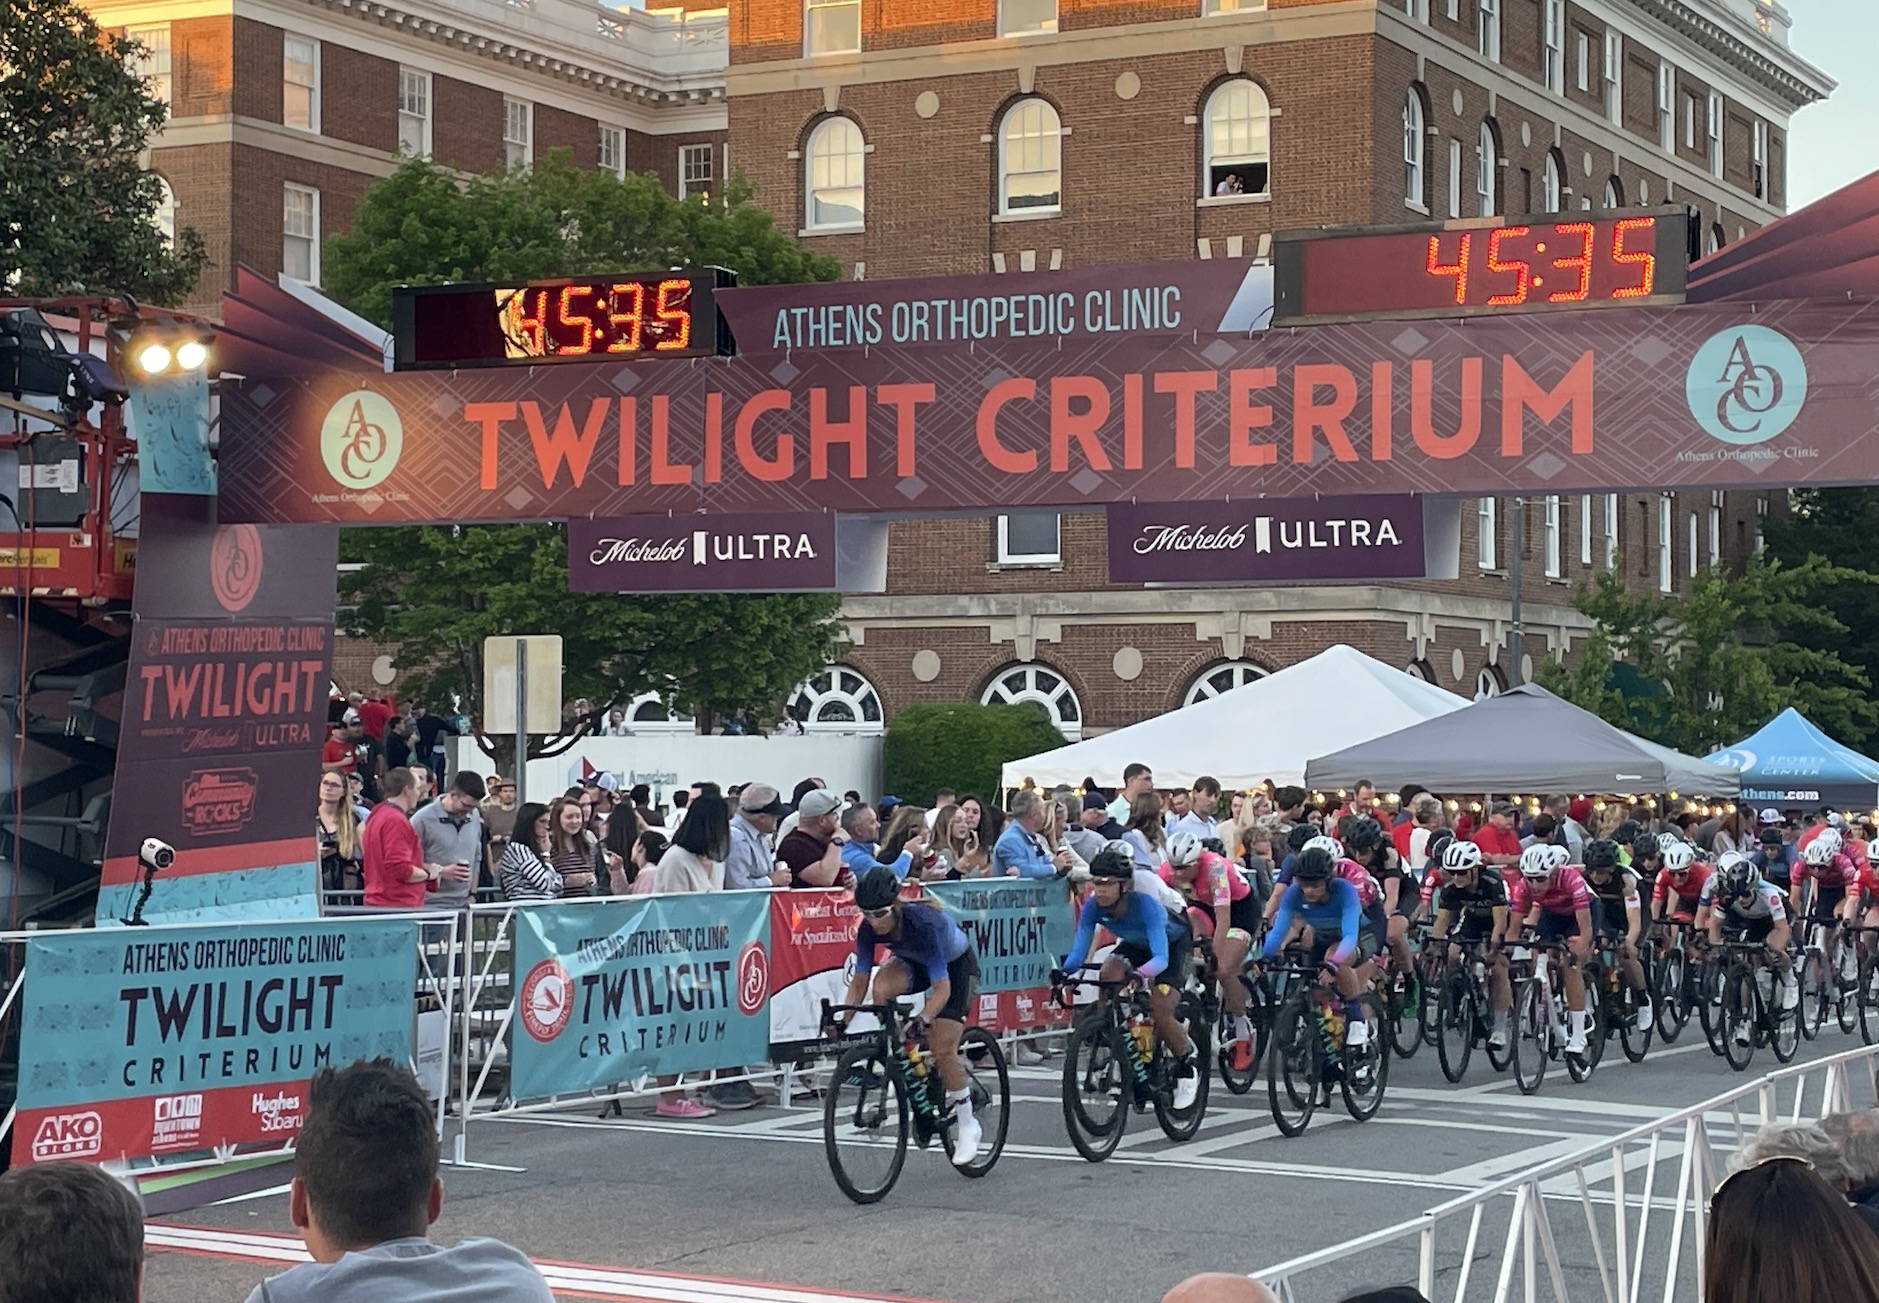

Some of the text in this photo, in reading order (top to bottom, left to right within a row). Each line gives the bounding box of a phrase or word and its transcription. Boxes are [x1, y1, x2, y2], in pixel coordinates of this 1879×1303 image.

[1426, 217, 1655, 305] 45:35
[512, 279, 691, 355] 45:35
[773, 285, 1182, 349] ATHENS ORTHOPEDIC CLINIC
[463, 350, 1595, 491] TWILIGHT CRITERIUM
[1675, 446, 1820, 462] Athens Orthopedic Clinic
[312, 493, 339, 503] Athens
[385, 490, 410, 502] Clinic
[589, 533, 815, 565] Michelob ULTRA
[1133, 519, 1400, 555] Michelob ULTRA
[161, 628, 209, 654] ATHENS
[210, 627, 284, 653] ORTHOPEDIC
[287, 626, 325, 652] CLINIC
[140, 661, 323, 721] TWILIGHT
[255, 722, 311, 746] ULTRA
[629, 770, 677, 786] American
[122, 933, 347, 975] ATHENS ORTHOPEDIC CLINIC
[695, 926, 730, 952] CLINIC
[582, 961, 731, 1024] TWILIGHT
[119, 975, 344, 1047] TWILIGHT
[579, 1019, 728, 1058] CRITERIUM
[123, 1042, 332, 1087] CRITERIUM
[252, 1091, 300, 1117] Hughes
[36, 1116, 100, 1144] AKO
[261, 1111, 304, 1132] Subaru
[39, 1139, 99, 1157] SIGNS
